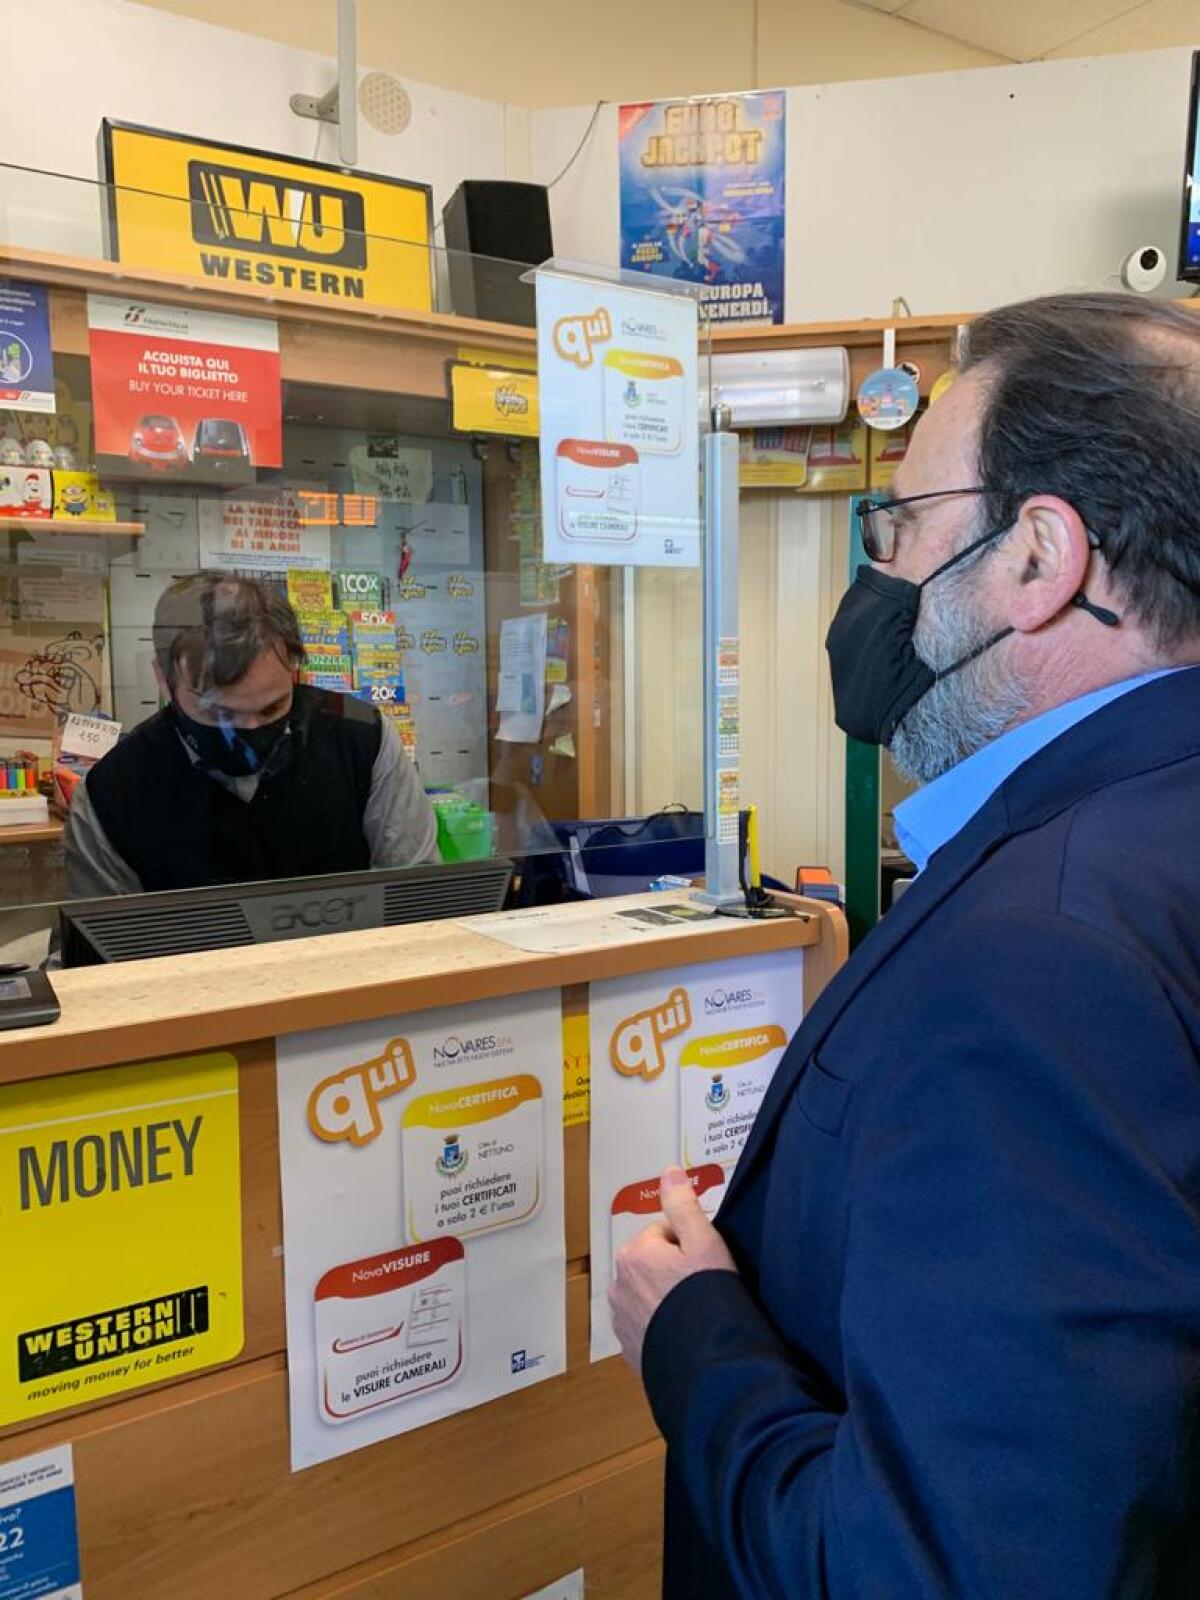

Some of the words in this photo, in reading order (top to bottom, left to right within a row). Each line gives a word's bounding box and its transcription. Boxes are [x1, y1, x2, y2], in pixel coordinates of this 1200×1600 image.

[202, 171, 346, 256] WU
[199, 252, 365, 299] WESTERN
[556, 309, 610, 365] qui
[138, 362, 149, 375] IL
[150, 364, 177, 376] TUO
[179, 367, 239, 384] BIGLIETTO
[143, 350, 204, 368] ACQUISTA
[205, 357, 230, 371] QUI
[128, 380, 151, 392] BUY
[153, 381, 185, 395] YOUR
[187, 385, 221, 400] TICKET
[222, 389, 248, 402] HERE
[271, 895, 367, 932] acer
[704, 988, 752, 1009] NOVARES
[433, 1035, 496, 1060] NOVARES
[616, 993, 687, 1073] qui
[315, 1044, 410, 1138] qui
[427, 1084, 520, 1115] NovaCERTIFICA
[18, 1115, 204, 1212] MONEY
[440, 1185, 462, 1201] puoi
[463, 1171, 512, 1191] richiedere
[441, 1198, 461, 1213] tuoi
[462, 1182, 518, 1206] CERTIFICATI
[446, 1211, 467, 1227] solo
[469, 1207, 476, 1219] 2
[478, 1203, 488, 1216] €
[351, 1250, 431, 1285] NovaVISURE
[24, 1299, 175, 1356] WESTERN
[74, 1318, 175, 1362] UNION
[27, 1377, 82, 1401] moving
[83, 1362, 131, 1386] money
[132, 1356, 153, 1372] for
[155, 1346, 195, 1365] better
[341, 1392, 351, 1404] le
[352, 1375, 392, 1398] VISURE
[393, 1358, 447, 1385] CAMERALI
[355, 1365, 380, 1386] puoi
[381, 1351, 432, 1376] richiedere
